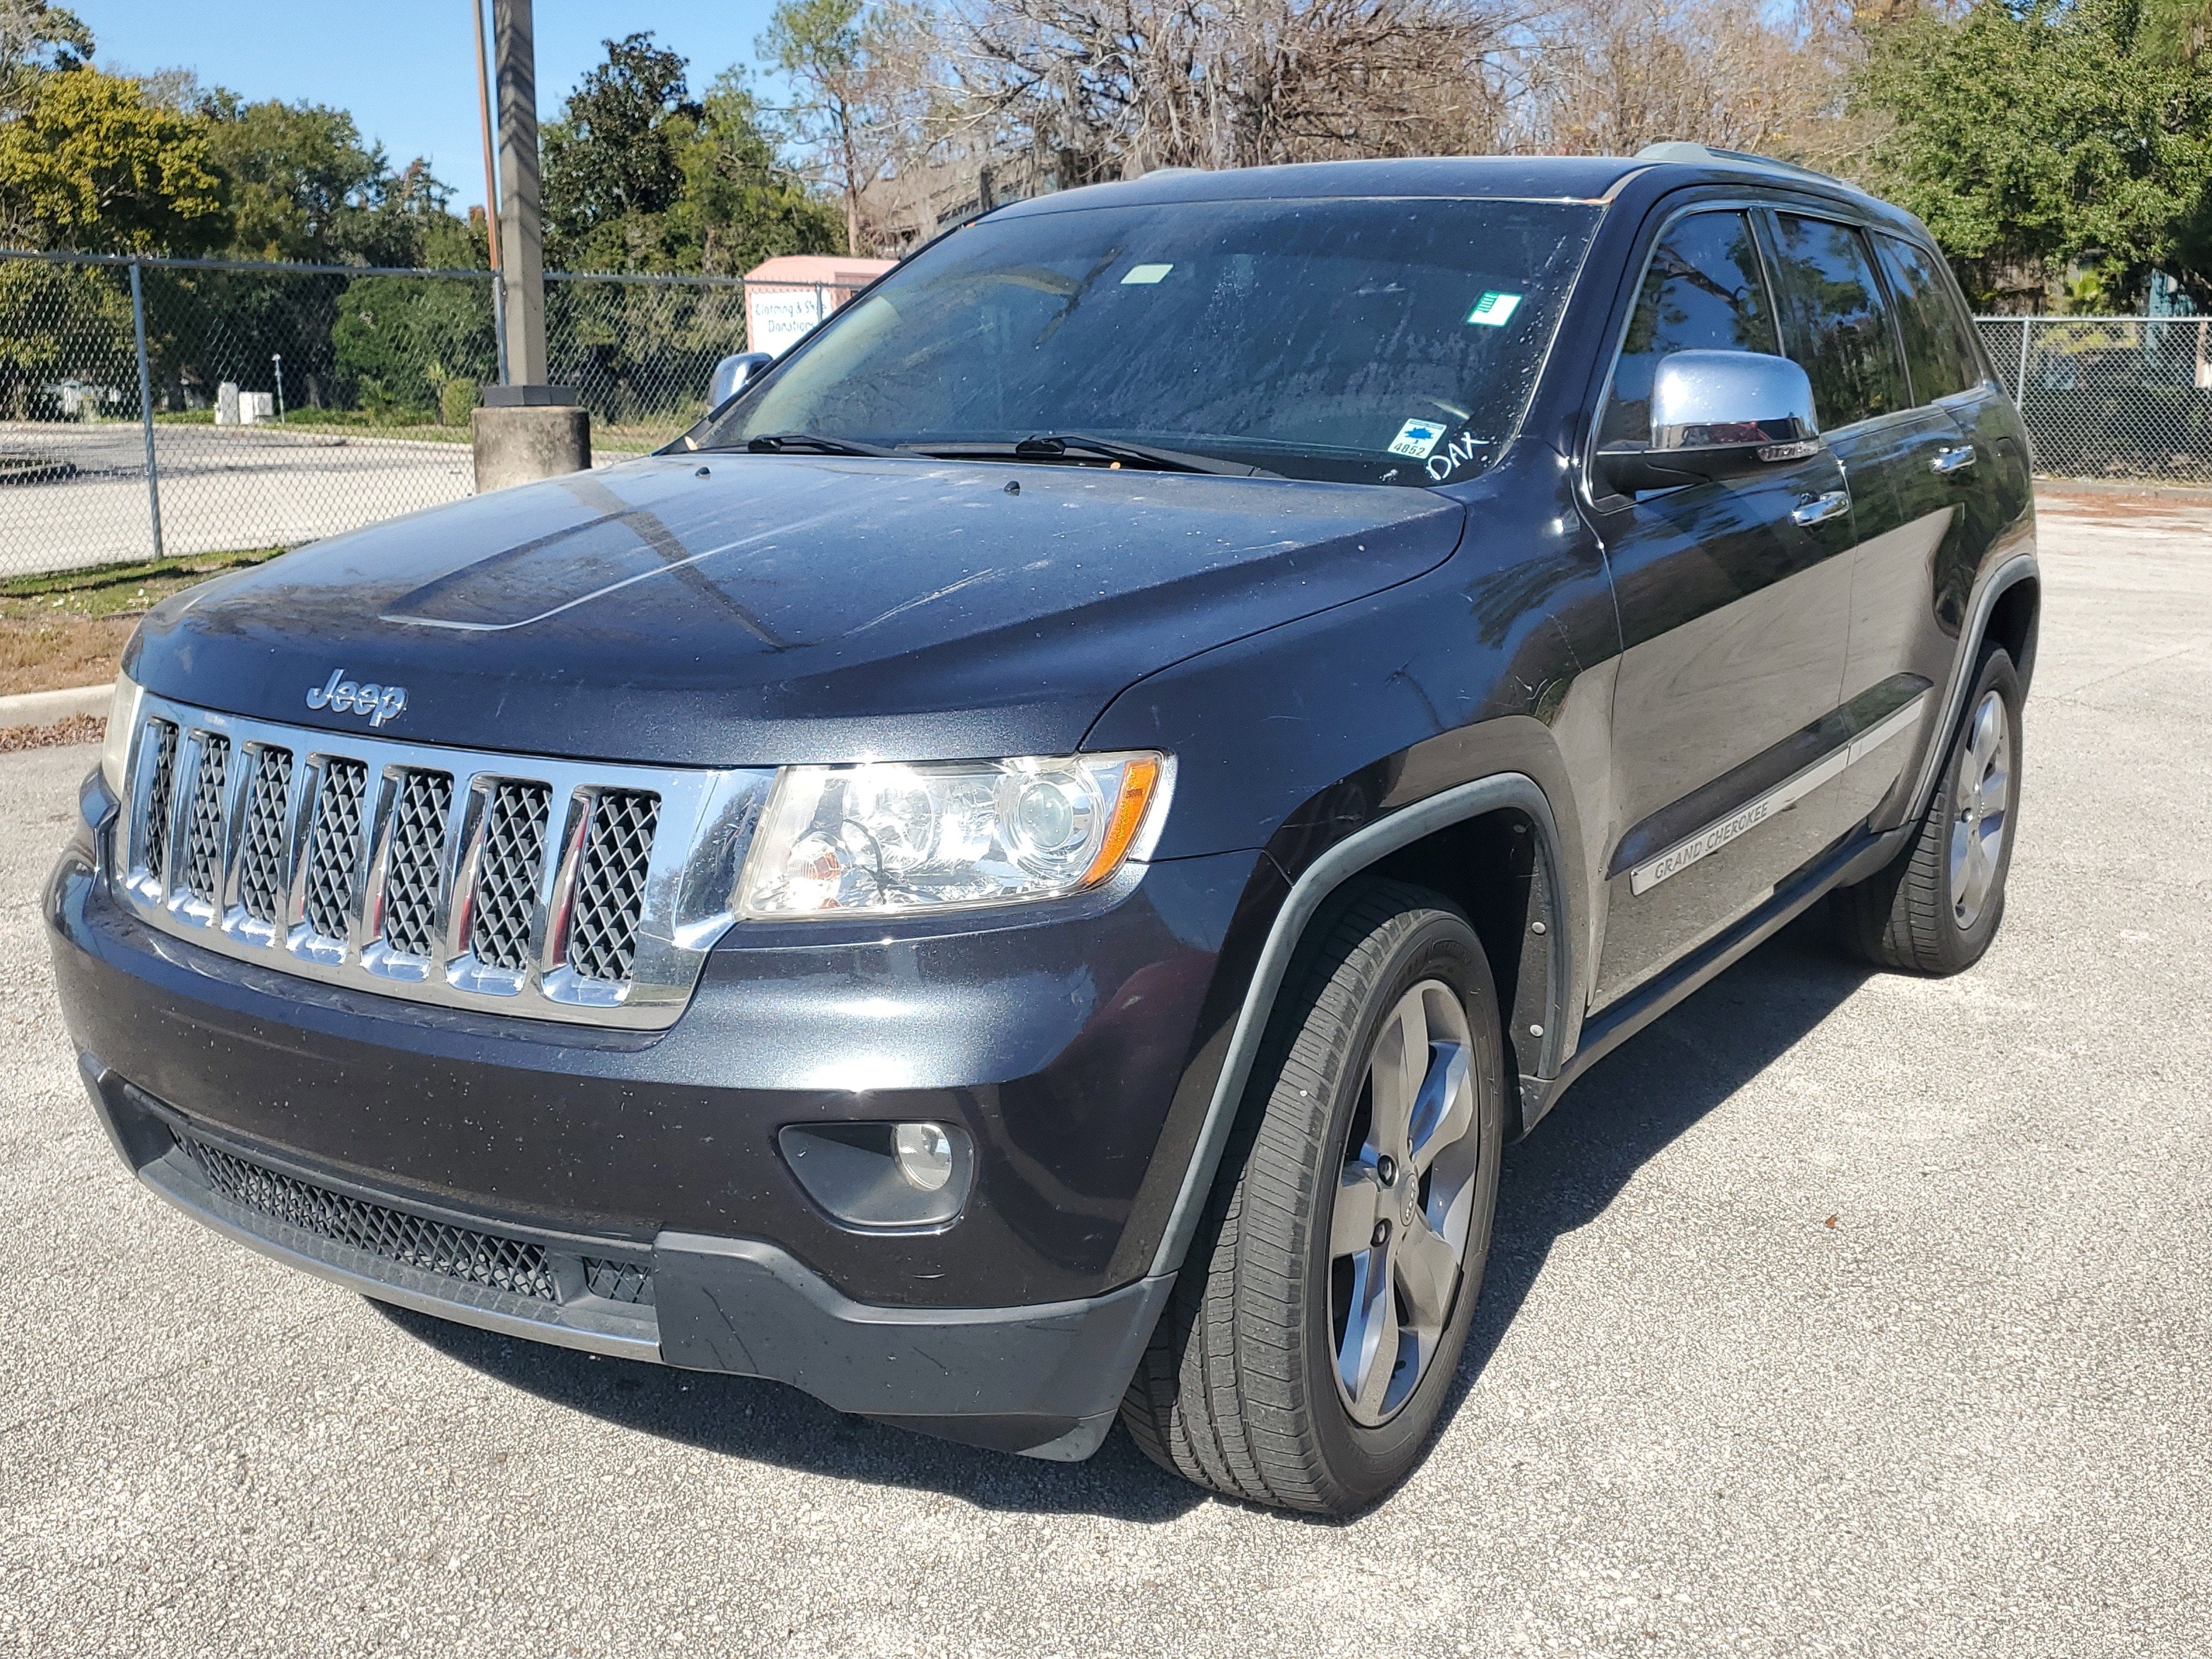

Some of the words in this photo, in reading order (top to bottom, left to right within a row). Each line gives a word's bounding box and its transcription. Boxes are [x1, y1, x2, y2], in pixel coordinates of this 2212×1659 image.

[804, 300, 827, 313] She
[1393, 442, 1425, 456] 4852
[1425, 431, 1489, 481] DAX
[306, 668, 408, 727] Jeep
[1655, 841, 1703, 878] GRAND
[1705, 801, 1769, 851] CHEROKEE
